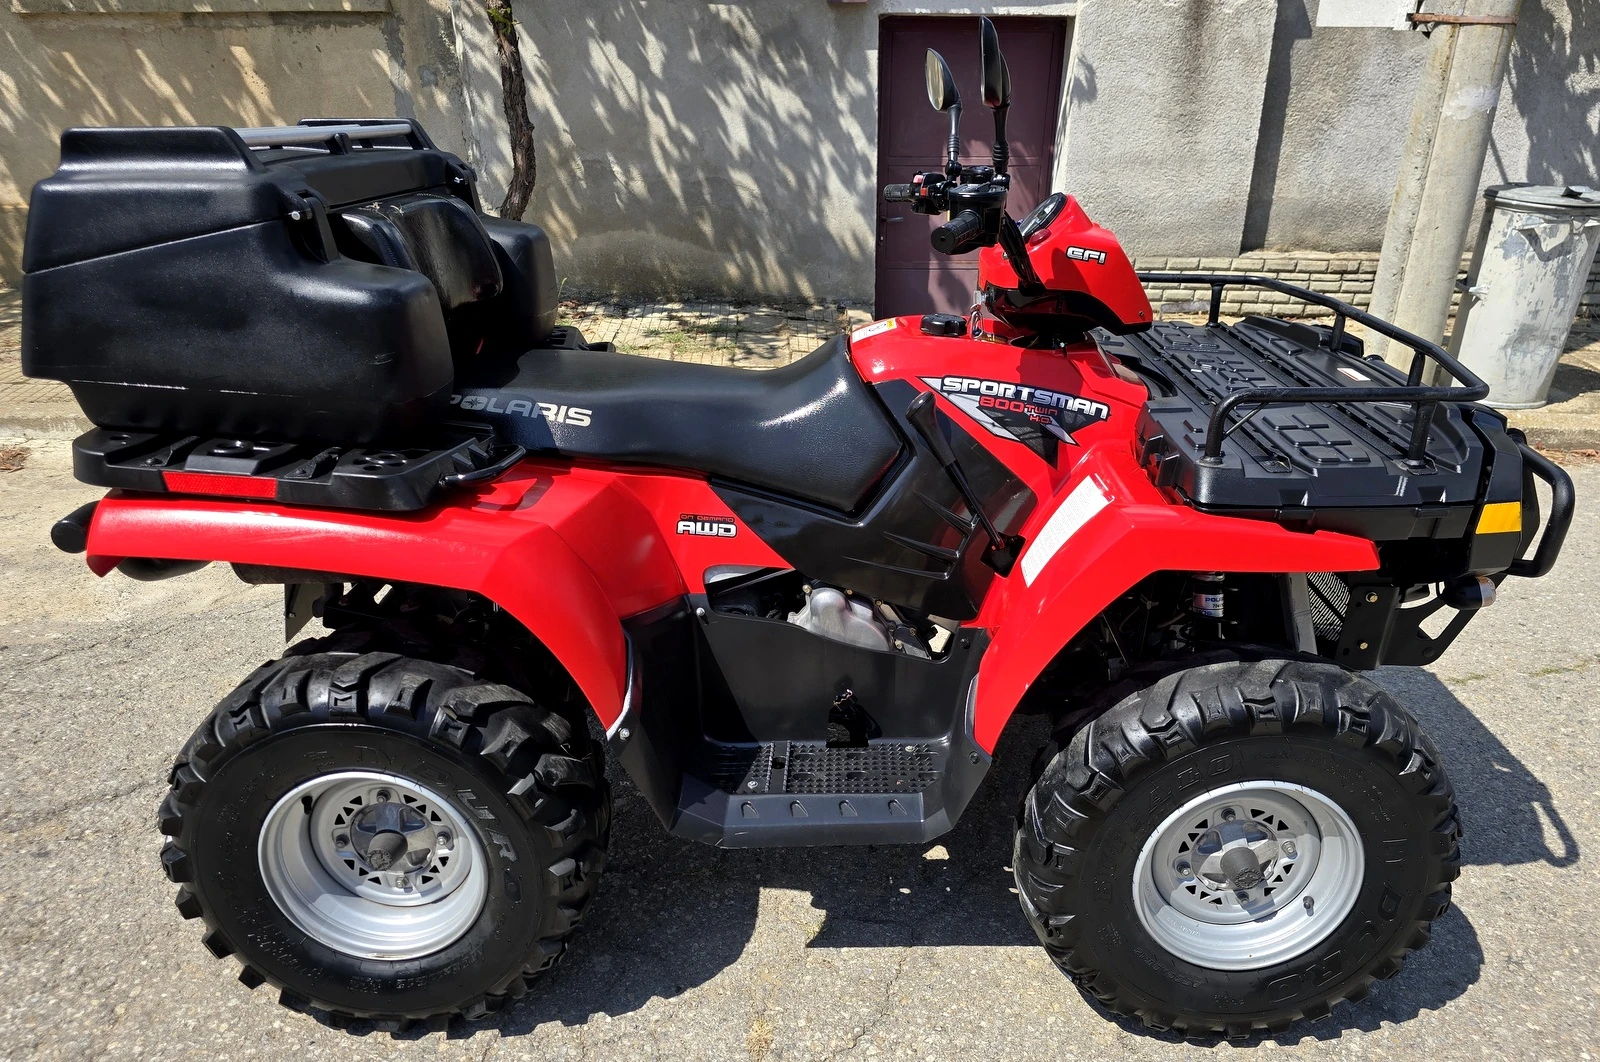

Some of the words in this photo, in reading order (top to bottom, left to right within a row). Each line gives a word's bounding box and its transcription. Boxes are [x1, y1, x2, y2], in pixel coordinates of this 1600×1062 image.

[1066, 246, 1106, 264] EFI
[942, 377, 1109, 420] SPORTSMAN
[979, 396, 1025, 413] 800
[1025, 404, 1058, 416] TWIN
[677, 520, 737, 537] AWD
[697, 515, 734, 523] DEMAND
[1264, 882, 1404, 1003] DURO
